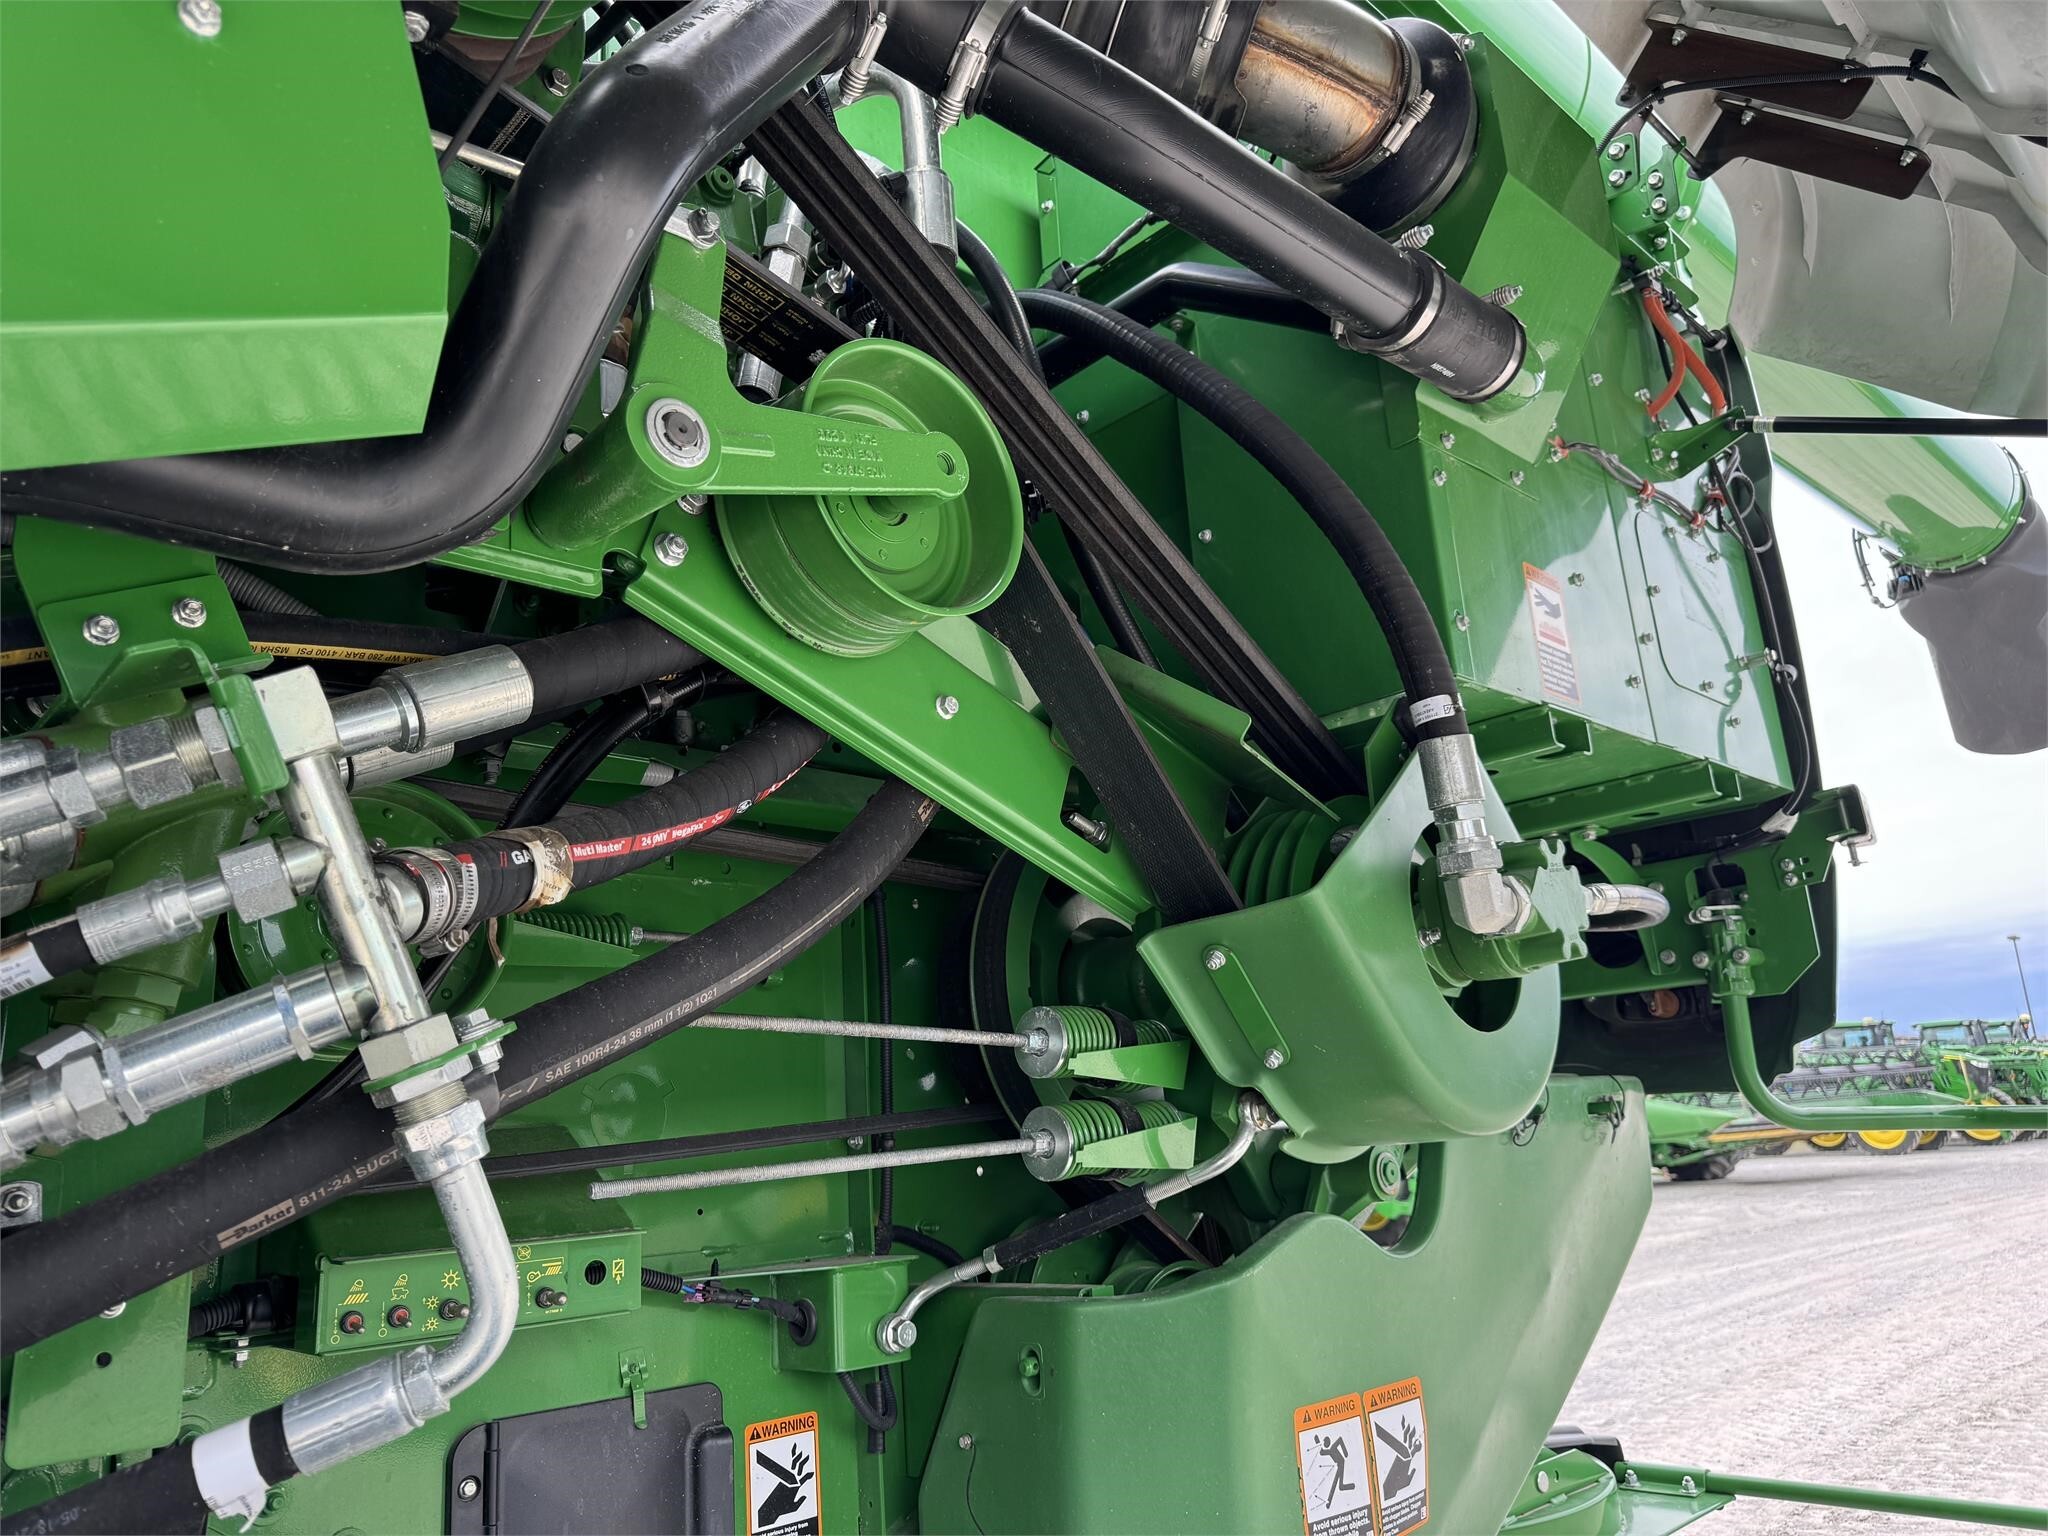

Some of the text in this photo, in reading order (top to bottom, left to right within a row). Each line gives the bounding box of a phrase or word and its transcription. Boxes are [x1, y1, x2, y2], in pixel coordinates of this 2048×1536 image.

[743, 280, 774, 304] JOHN
[729, 291, 760, 315] JOHN
[260, 643, 290, 656] MSHA
[296, 647, 314, 656] PSI
[315, 648, 338, 658] 4100
[345, 650, 366, 661] BAR
[367, 652, 384, 660] 280
[385, 654, 400, 663] WP
[403, 654, 423, 663] MAX
[640, 836, 652, 847] 24
[543, 1062, 574, 1083] SAE
[574, 1036, 628, 1067] 100R4-24
[627, 1027, 643, 1041] 38
[641, 1016, 665, 1033] mm
[664, 1011, 676, 1023] (1
[674, 1000, 696, 1017] 1/2)
[695, 987, 719, 1006] 1Q21
[229, 1148, 400, 1240] Parker 811-24 SUCT
[1378, 1383, 1417, 1404] WARNING
[1315, 1400, 1355, 1419] WARNING
[762, 1415, 815, 1435] WARNING
[1313, 1509, 1368, 1530] Avoid serious injury
[1329, 1525, 1348, 1535] thrown
[1349, 1518, 1369, 1531] objects.
[784, 1524, 797, 1533] injury
